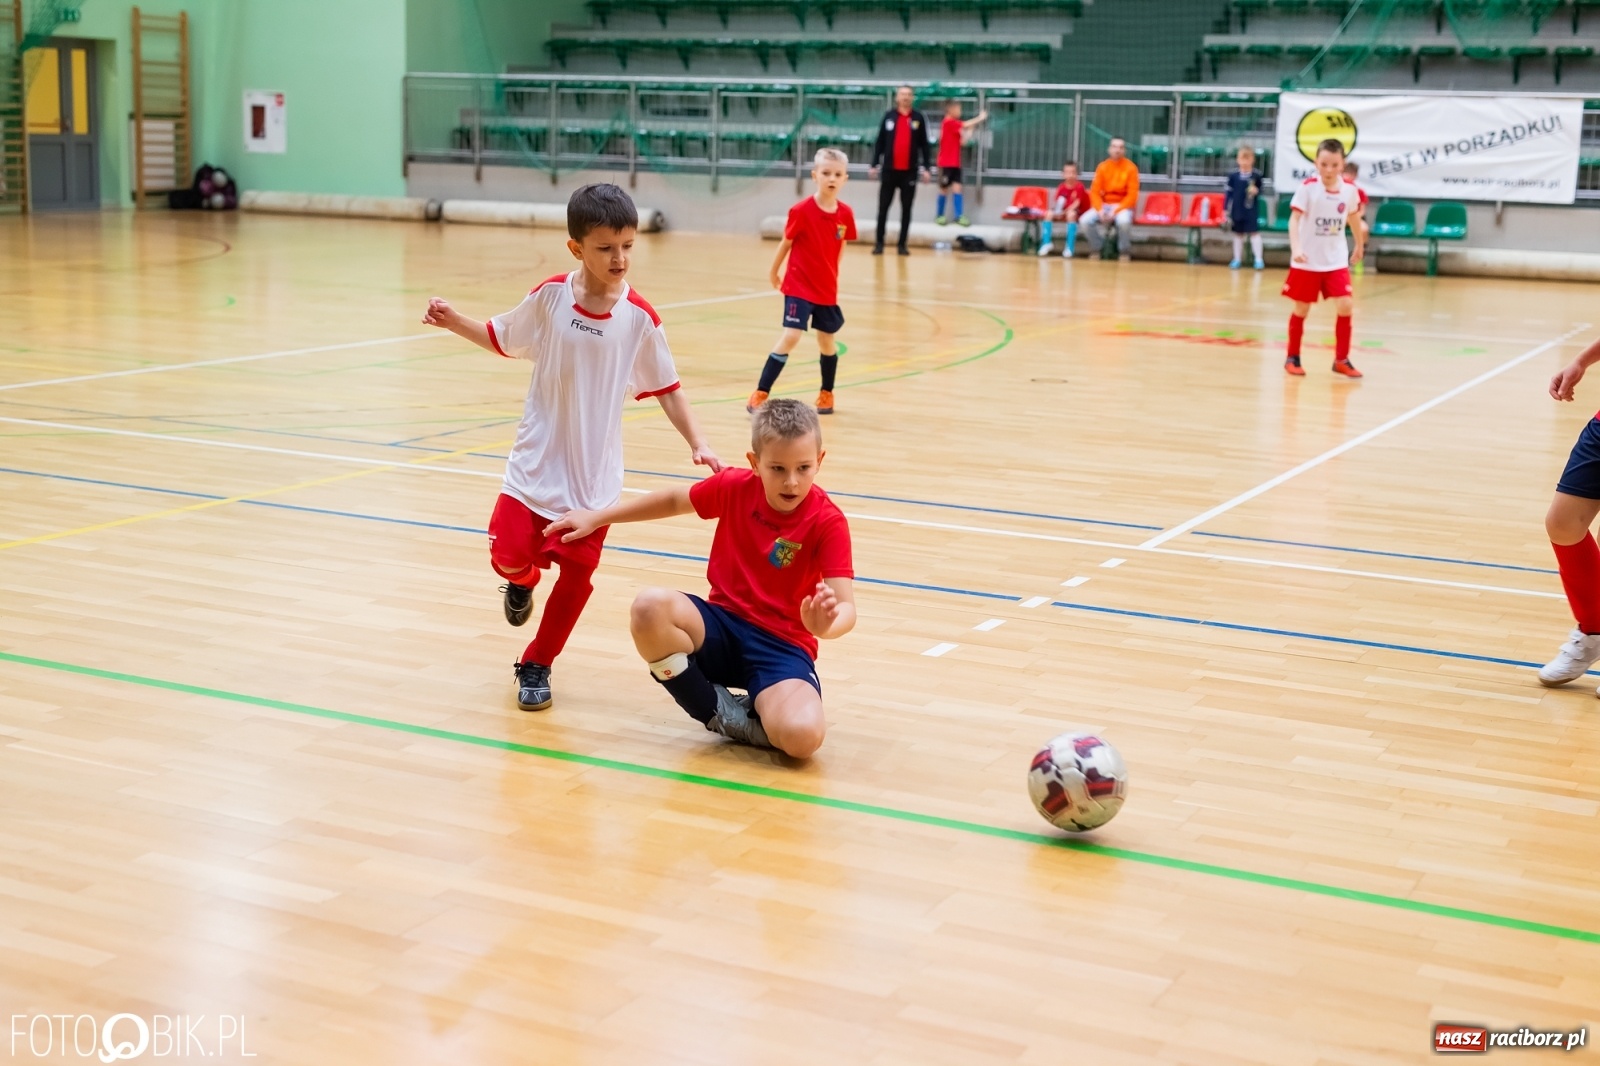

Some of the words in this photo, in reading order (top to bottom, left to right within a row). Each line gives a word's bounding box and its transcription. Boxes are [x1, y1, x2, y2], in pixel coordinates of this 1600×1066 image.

[1370, 152, 1412, 178] JEST
[1418, 147, 1438, 166] W
[1444, 115, 1563, 157] PORZĄDKU!
